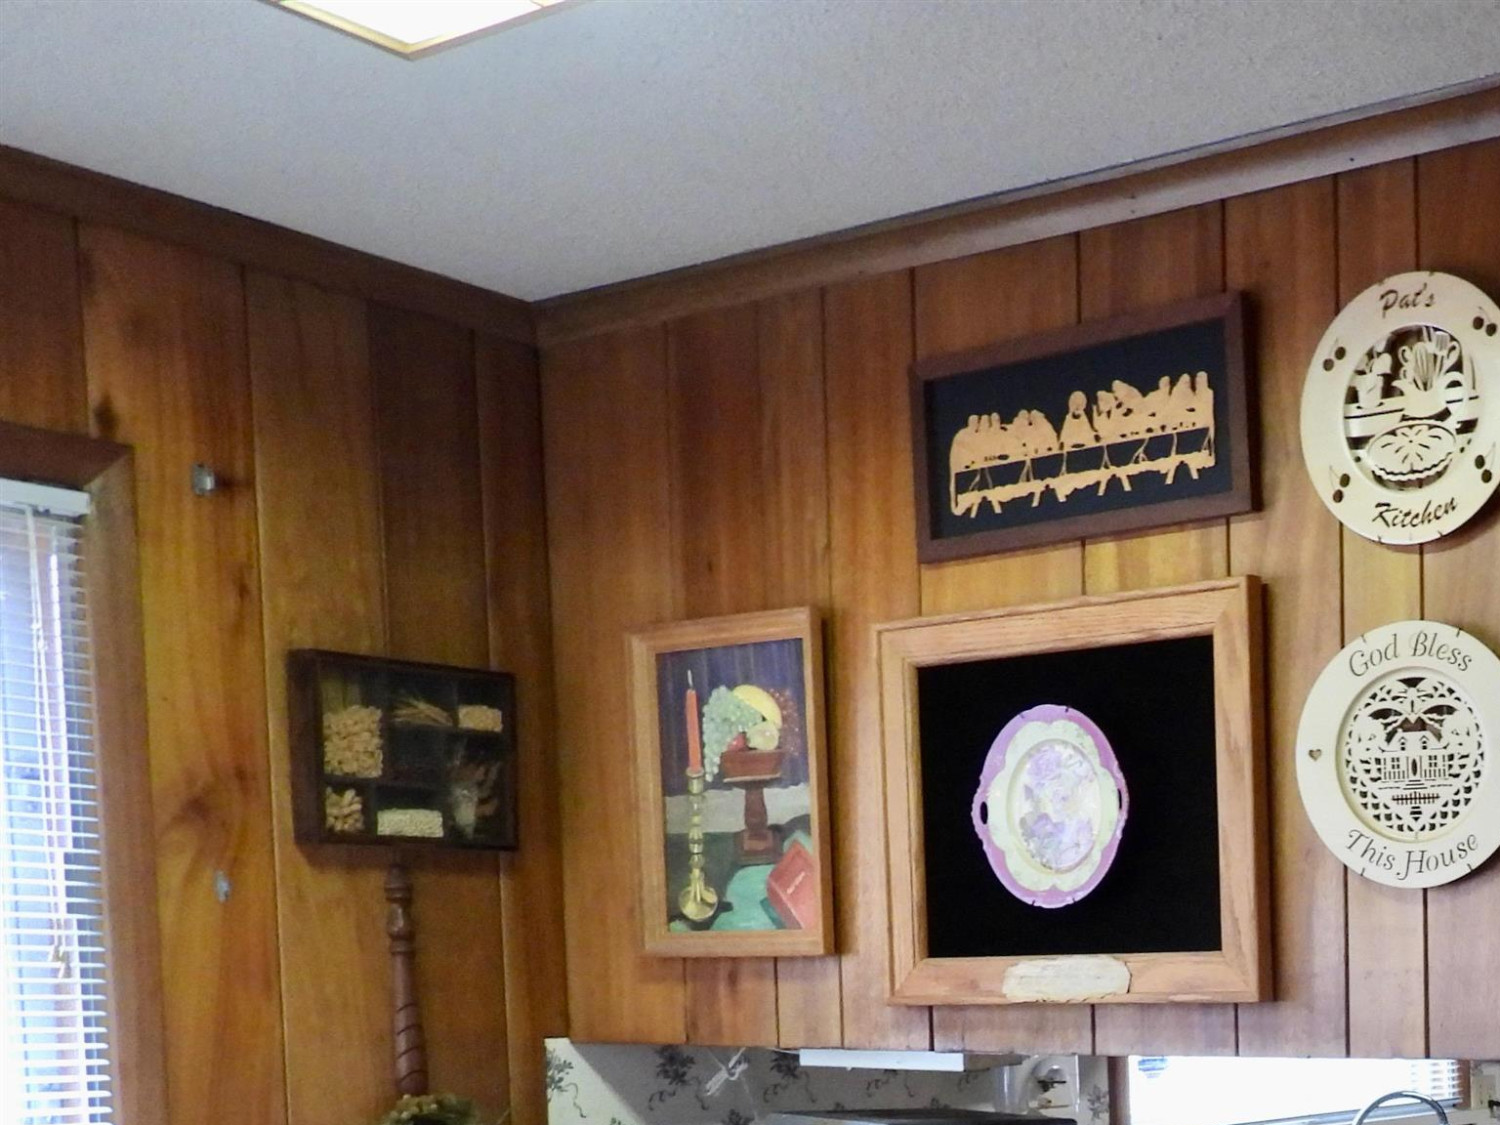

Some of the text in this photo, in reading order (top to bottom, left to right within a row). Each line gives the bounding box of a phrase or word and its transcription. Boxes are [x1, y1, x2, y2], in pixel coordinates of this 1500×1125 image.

[1379, 282, 1436, 319] Pat's
[1372, 497, 1457, 528] Kitchen
[1349, 629, 1472, 677] God Bless
[1346, 829, 1478, 880] This House
